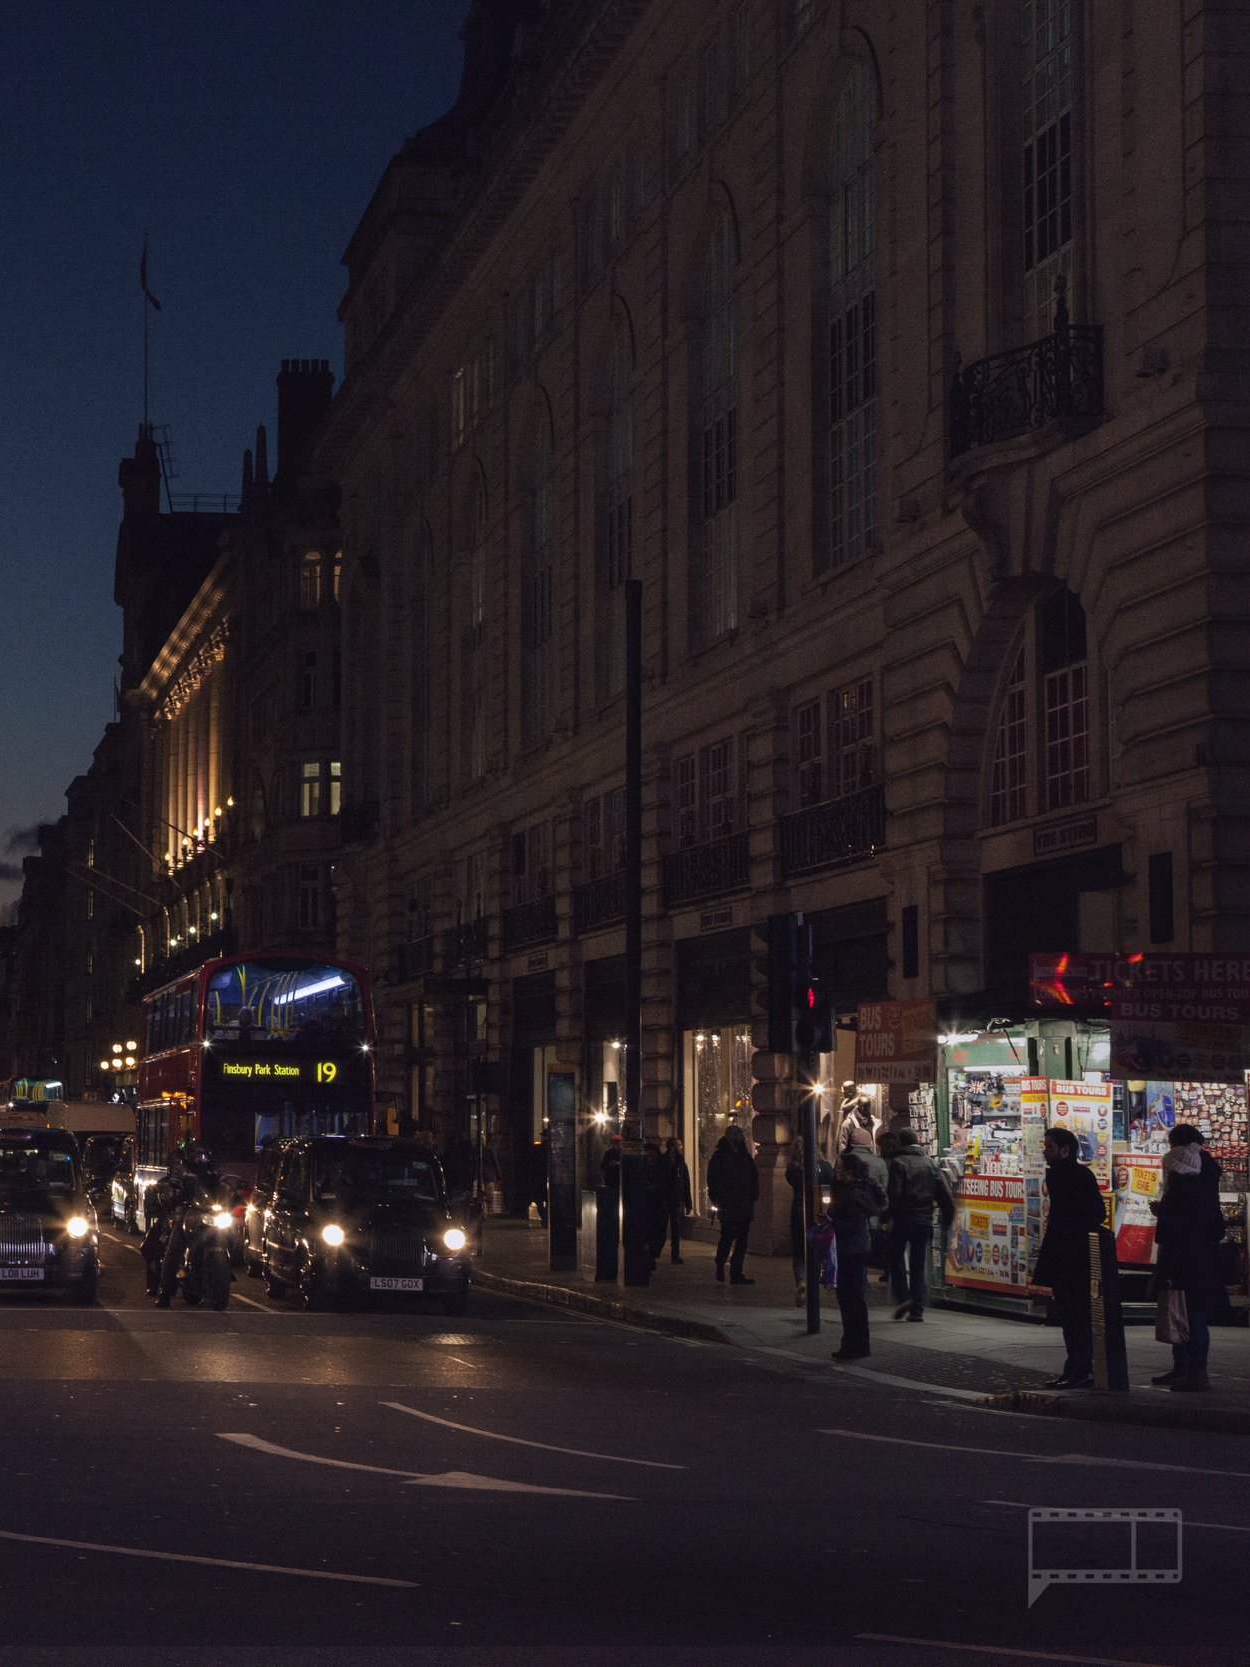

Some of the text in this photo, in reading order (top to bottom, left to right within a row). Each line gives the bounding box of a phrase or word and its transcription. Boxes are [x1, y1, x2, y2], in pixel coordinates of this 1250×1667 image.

[1193, 959, 1250, 982] HERE
[860, 1006, 881, 1030] BUS
[1120, 1002, 1240, 1020] BUS TOURS
[859, 1032, 895, 1058] TOURS
[223, 1062, 337, 1083] Finsbury Park Station 19
[1056, 1084, 1075, 1094] BUS
[1076, 1086, 1108, 1096] TOURS
[990, 1181, 1004, 1198] BUS
[374, 1278, 399, 1289] LS07
